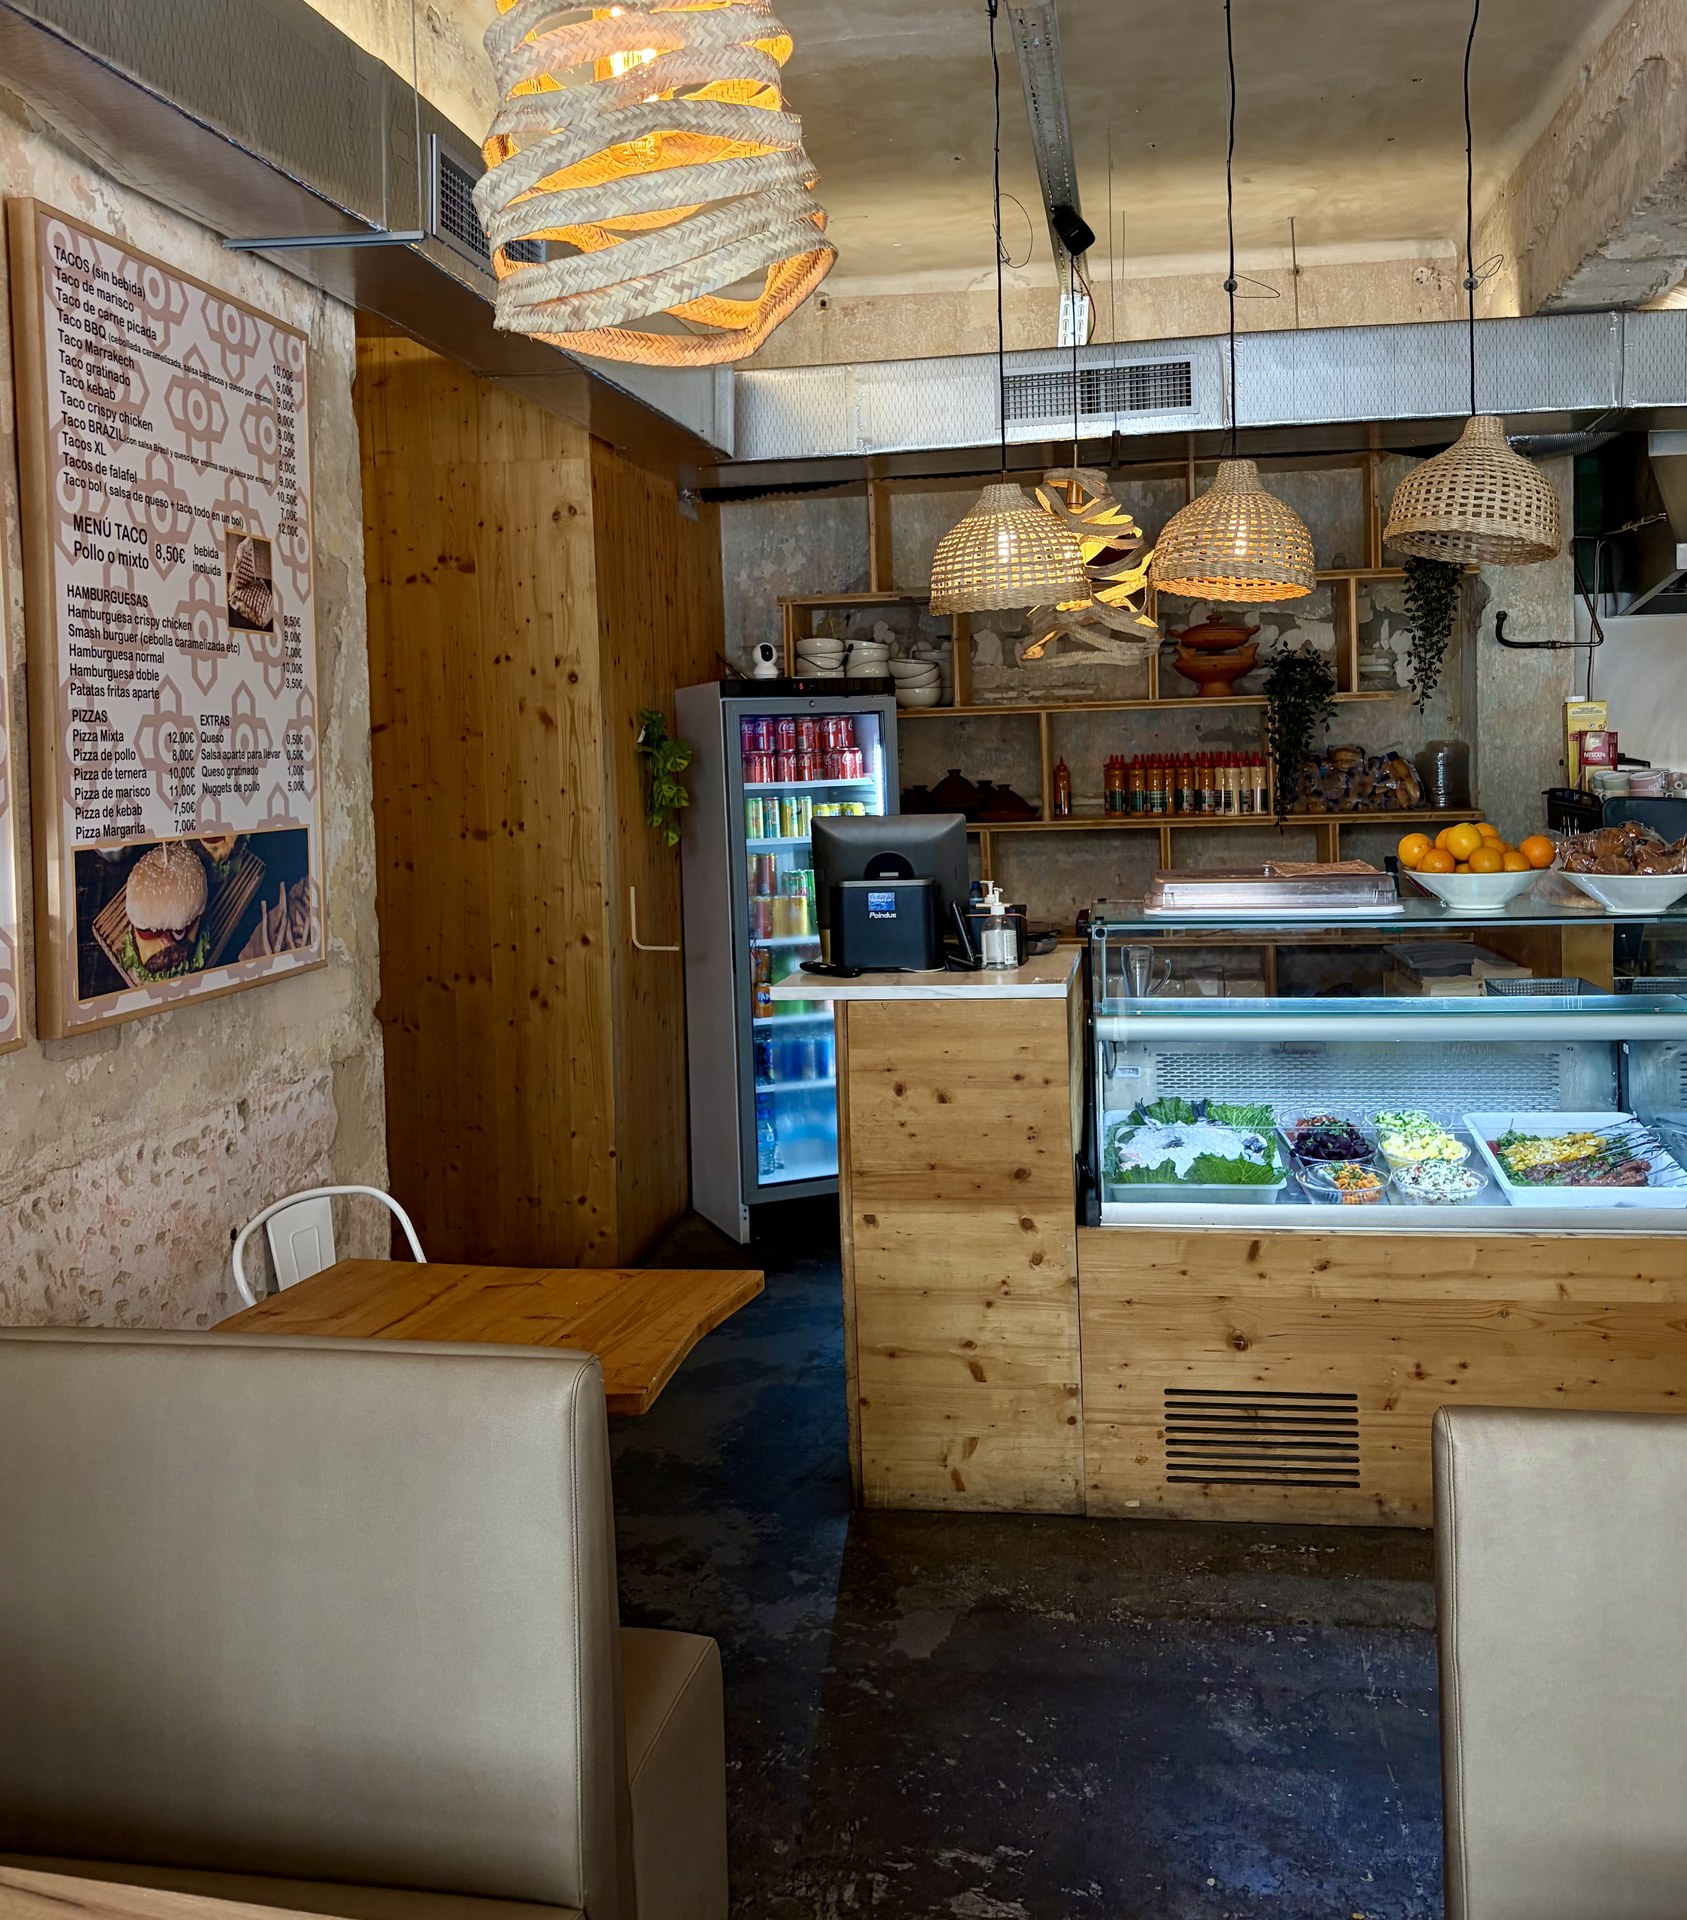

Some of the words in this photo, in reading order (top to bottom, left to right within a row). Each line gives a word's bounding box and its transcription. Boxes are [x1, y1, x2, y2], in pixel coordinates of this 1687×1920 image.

[54, 245, 90, 273] TACOS
[92, 263, 110, 283] (sin
[112, 272, 146, 302] bebida)
[54, 266, 80, 289] Taco
[82, 279, 95, 295] de
[97, 288, 134, 312] marisco
[273, 364, 294, 382] 10,00€
[55, 286, 81, 309] Taco
[83, 300, 96, 316] de
[98, 308, 125, 328] carne
[127, 321, 157, 341] picada
[276, 381, 294, 397] 9,00€
[56, 307, 81, 330] Taco
[84, 319, 107, 341] BBQ
[184, 364, 199, 376] salsa
[199, 369, 224, 386] barbacoa
[229, 382, 245, 394] queso
[245, 389, 254, 397] por
[276, 397, 295, 413] 9,00€
[57, 328, 83, 350] Taco
[85, 338, 135, 370] Marrakech
[277, 413, 295, 428] 8,00€
[58, 348, 84, 370] Taco
[86, 362, 131, 387] gratinado
[277, 429, 295, 444] 8,00€
[59, 369, 84, 390] Taco
[86, 378, 116, 401] kebab
[278, 445, 296, 460] 7,50€
[60, 389, 85, 410] Taco
[87, 402, 117, 423] crispy
[119, 411, 154, 432] chicken
[278, 460, 297, 475] 8,00€
[61, 410, 86, 430] Taco
[138, 440, 153, 451] salsa
[153, 443, 169, 455] Brasil
[174, 451, 190, 462] queso
[190, 456, 200, 465] por
[200, 459, 218, 471] encima
[229, 466, 234, 475] la
[234, 468, 247, 478] salsa
[246, 473, 255, 481] por
[279, 475, 297, 491] 9,00€
[61, 431, 93, 452] Tacos
[94, 440, 107, 456] XL
[276, 491, 298, 507] 10,50€
[62, 451, 93, 472] Tacos
[95, 461, 108, 476] de
[109, 464, 138, 484] falafel
[280, 507, 298, 522] 7,00€
[63, 471, 86, 489] Taco
[88, 480, 102, 493] bol
[109, 485, 131, 500] salsa
[132, 490, 144, 503] de
[145, 495, 169, 508] queso
[170, 500, 175, 509] +
[176, 501, 193, 515] taco
[194, 505, 211, 519] todo
[211, 512, 220, 522] en
[221, 514, 230, 524] un
[230, 515, 244, 530] bol)
[278, 523, 299, 538] 12,00€
[73, 513, 112, 538] MENÚ
[114, 523, 148, 545] TACO
[74, 540, 105, 562] Pollo
[107, 551, 115, 564] o
[118, 550, 149, 570] mixto
[155, 543, 186, 565] 8,50€
[193, 543, 219, 560] bebida
[192, 560, 222, 577] incluida
[66, 583, 149, 608] HAMBURGUESAS
[67, 603, 133, 625] Hamburguesa
[134, 613, 160, 631] crispy
[161, 616, 192, 632] chicken
[283, 615, 301, 628] 8,50€
[68, 623, 101, 640] Smash
[102, 627, 138, 645] burguer
[140, 631, 173, 647] (cebolla
[174, 637, 225, 652] caramelizada
[226, 642, 240, 656] etc)
[284, 631, 302, 643] 9,00€
[69, 643, 134, 663] Hamburguesa
[135, 651, 165, 664] normal
[285, 646, 302, 659] 7,00€
[69, 663, 134, 682] Hamburguesa
[135, 668, 160, 682] doble
[282, 661, 303, 675] 10,00€
[70, 683, 105, 697] Patatas
[107, 684, 130, 698] fritas
[132, 687, 160, 702] aparte
[286, 678, 303, 690] 3,50€
[72, 709, 108, 723] PIZZAS
[200, 714, 230, 727] EXTRAS
[72, 729, 98, 742] Pizza
[100, 729, 124, 742] Mixta
[168, 731, 195, 746] 12,00€
[200, 731, 224, 744] Queso
[286, 734, 304, 746] 0,50€
[73, 748, 98, 762] Pizza
[100, 748, 113, 761] de
[114, 748, 136, 764] pollo
[172, 749, 195, 763] 8,00€
[201, 748, 222, 760] Salsa
[222, 751, 246, 762] aparte
[246, 751, 262, 762] para
[263, 748, 281, 759] llevar
[286, 750, 304, 762] 0,50€
[74, 768, 99, 781] Pizza
[101, 767, 113, 780] de
[114, 767, 147, 779] ternera
[168, 766, 196, 781] 10,00€
[201, 766, 225, 777] Queso
[226, 765, 259, 779] gratinado
[287, 765, 305, 778] 1,00€
[74, 787, 100, 801] Pizza
[102, 786, 113, 799] de
[115, 785, 151, 798] marisco
[169, 784, 196, 798] 11,00€
[202, 782, 232, 797] Nuggets
[233, 781, 242, 790] de
[243, 781, 260, 794] pollo
[287, 781, 305, 794] 5,00€
[75, 806, 100, 820] Pizza
[102, 805, 114, 818] de
[116, 803, 142, 817] kebab
[173, 801, 196, 816] 7,50€
[75, 826, 101, 840] Pizza
[103, 822, 146, 839] Margarita
[174, 819, 196, 833] 7,00€
[869, 911, 897, 919] Poindus
